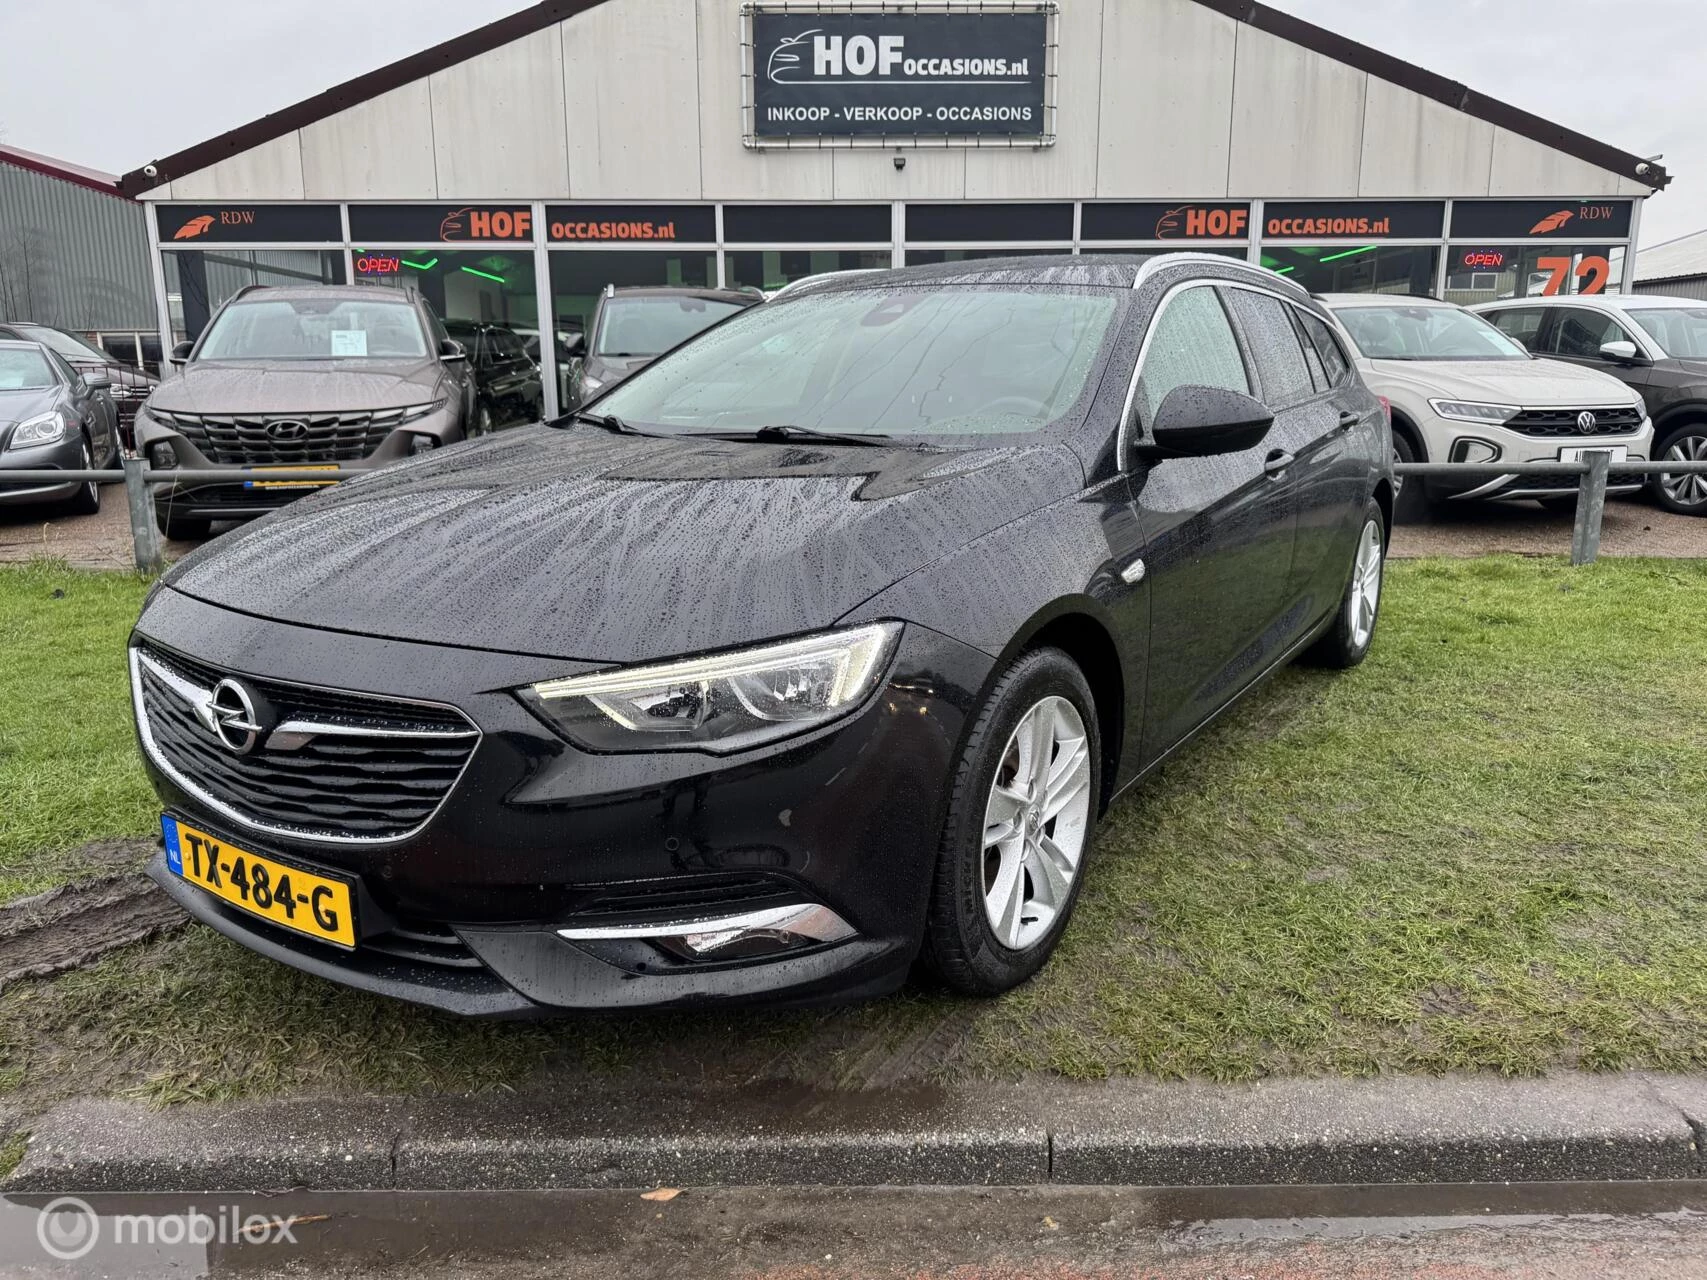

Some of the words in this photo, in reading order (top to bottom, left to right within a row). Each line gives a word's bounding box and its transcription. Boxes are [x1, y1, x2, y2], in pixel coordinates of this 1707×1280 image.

[767, 107, 830, 121] INKOOP
[844, 107, 923, 121] VERKOOP
[936, 106, 1032, 121] OCCASIONS
[220, 211, 256, 225] RDW
[1579, 206, 1614, 219] RDW
[470, 211, 531, 238] HOF
[551, 222, 676, 239] OCCASIONS.nl
[1185, 209, 1248, 236] HOF
[1267, 217, 1390, 235] OCCASIONS.nl
[357, 257, 400, 273] OPEN
[1464, 253, 1503, 267] OPEN
[1536, 255, 1610, 297] 72
[169, 849, 181, 865] NL
[184, 833, 339, 932] TX-484-G
